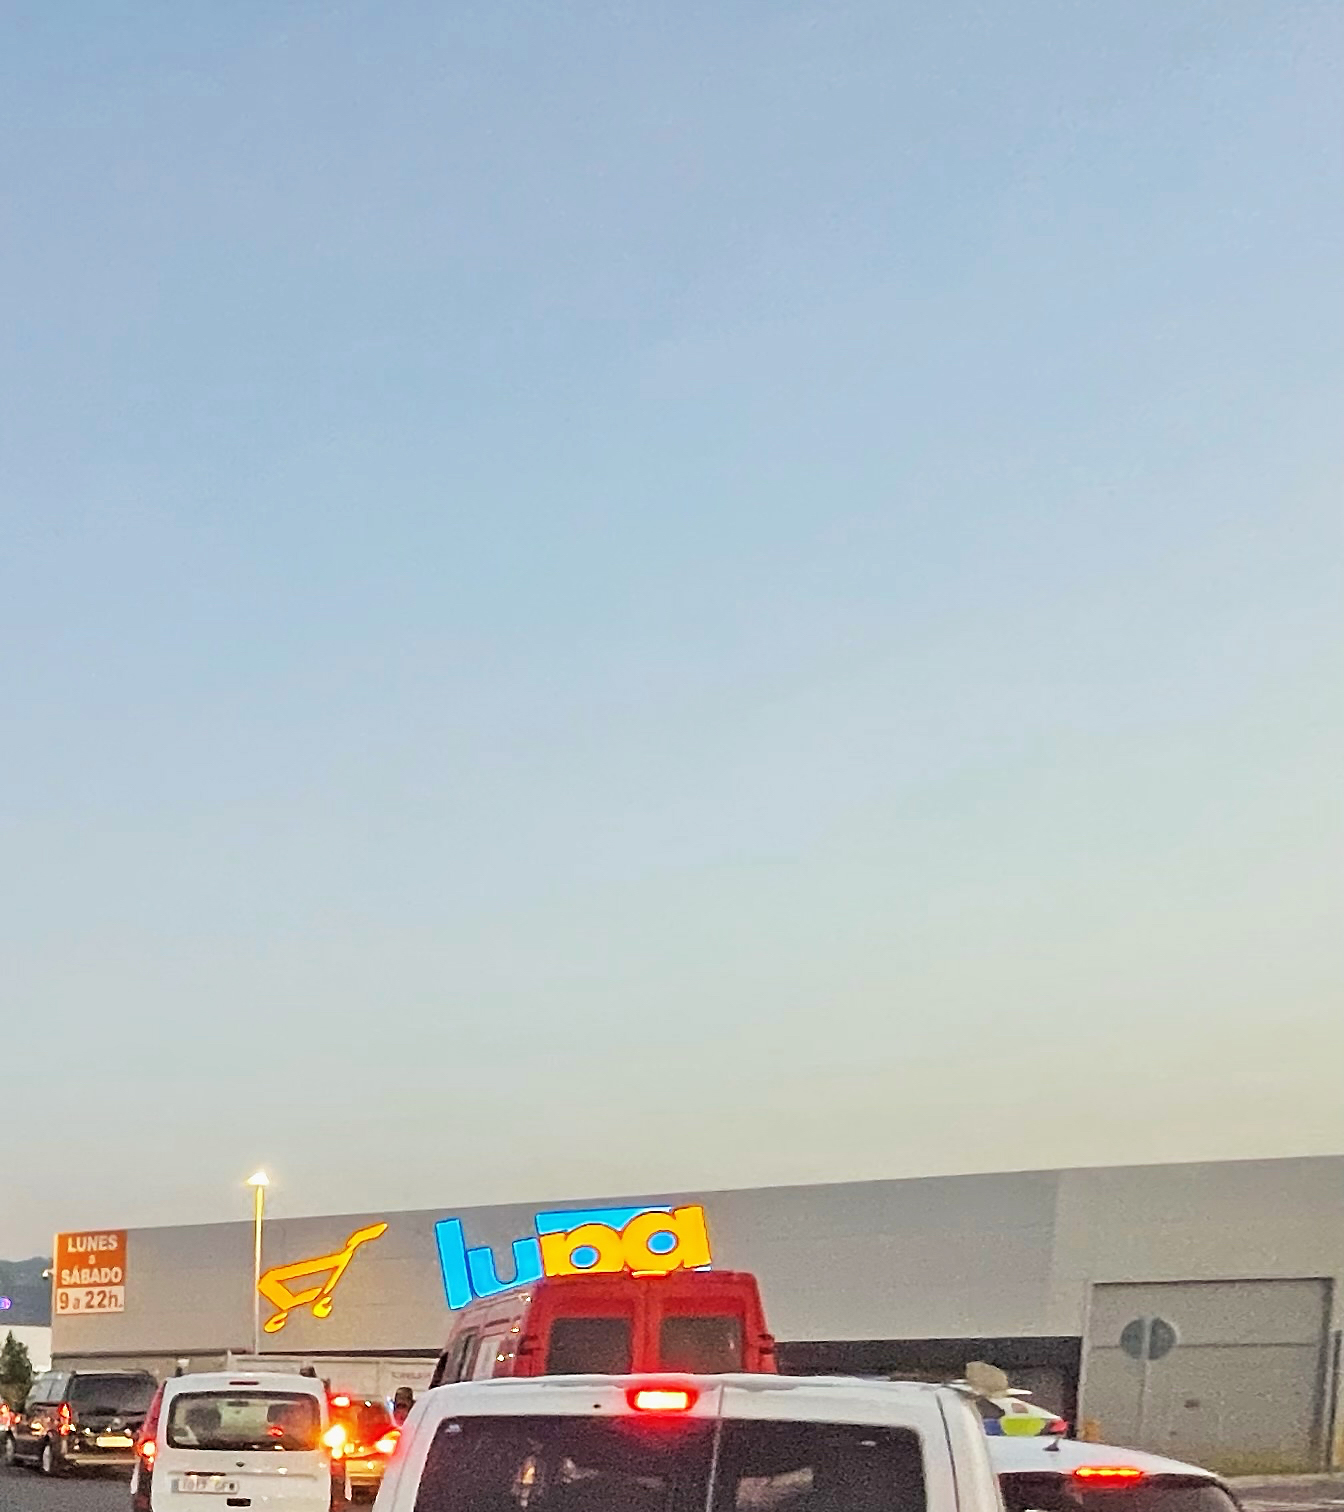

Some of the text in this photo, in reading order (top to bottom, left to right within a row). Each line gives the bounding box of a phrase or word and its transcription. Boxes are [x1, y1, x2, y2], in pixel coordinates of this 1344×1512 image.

[67, 1234, 118, 1253] LUNES
[435, 1205, 712, 1310] lupa
[61, 1265, 123, 1285] SÁBADO
[59, 1292, 69, 1310] 9
